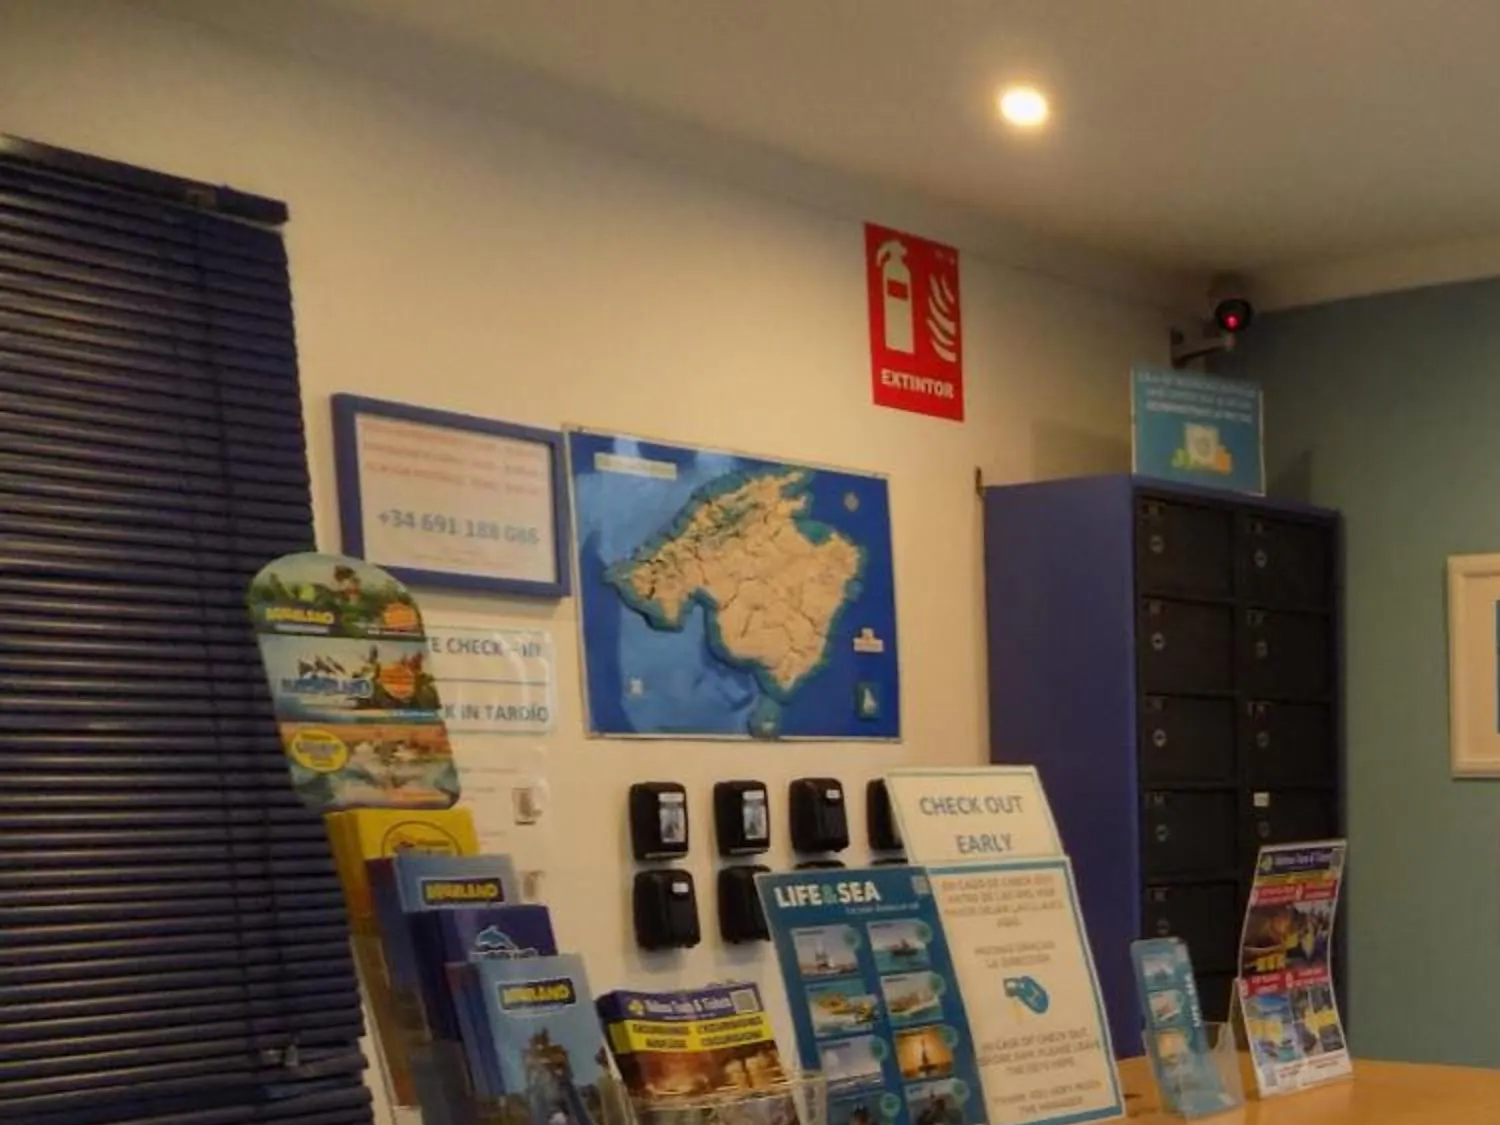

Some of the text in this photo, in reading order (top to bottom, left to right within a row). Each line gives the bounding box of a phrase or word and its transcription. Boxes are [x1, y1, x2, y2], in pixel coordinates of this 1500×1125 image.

[881, 367, 954, 399] EXTINTOR
[446, 637, 503, 657] CHECK
[919, 795, 1024, 816] CHECK OUT
[955, 833, 1013, 854] EARLY
